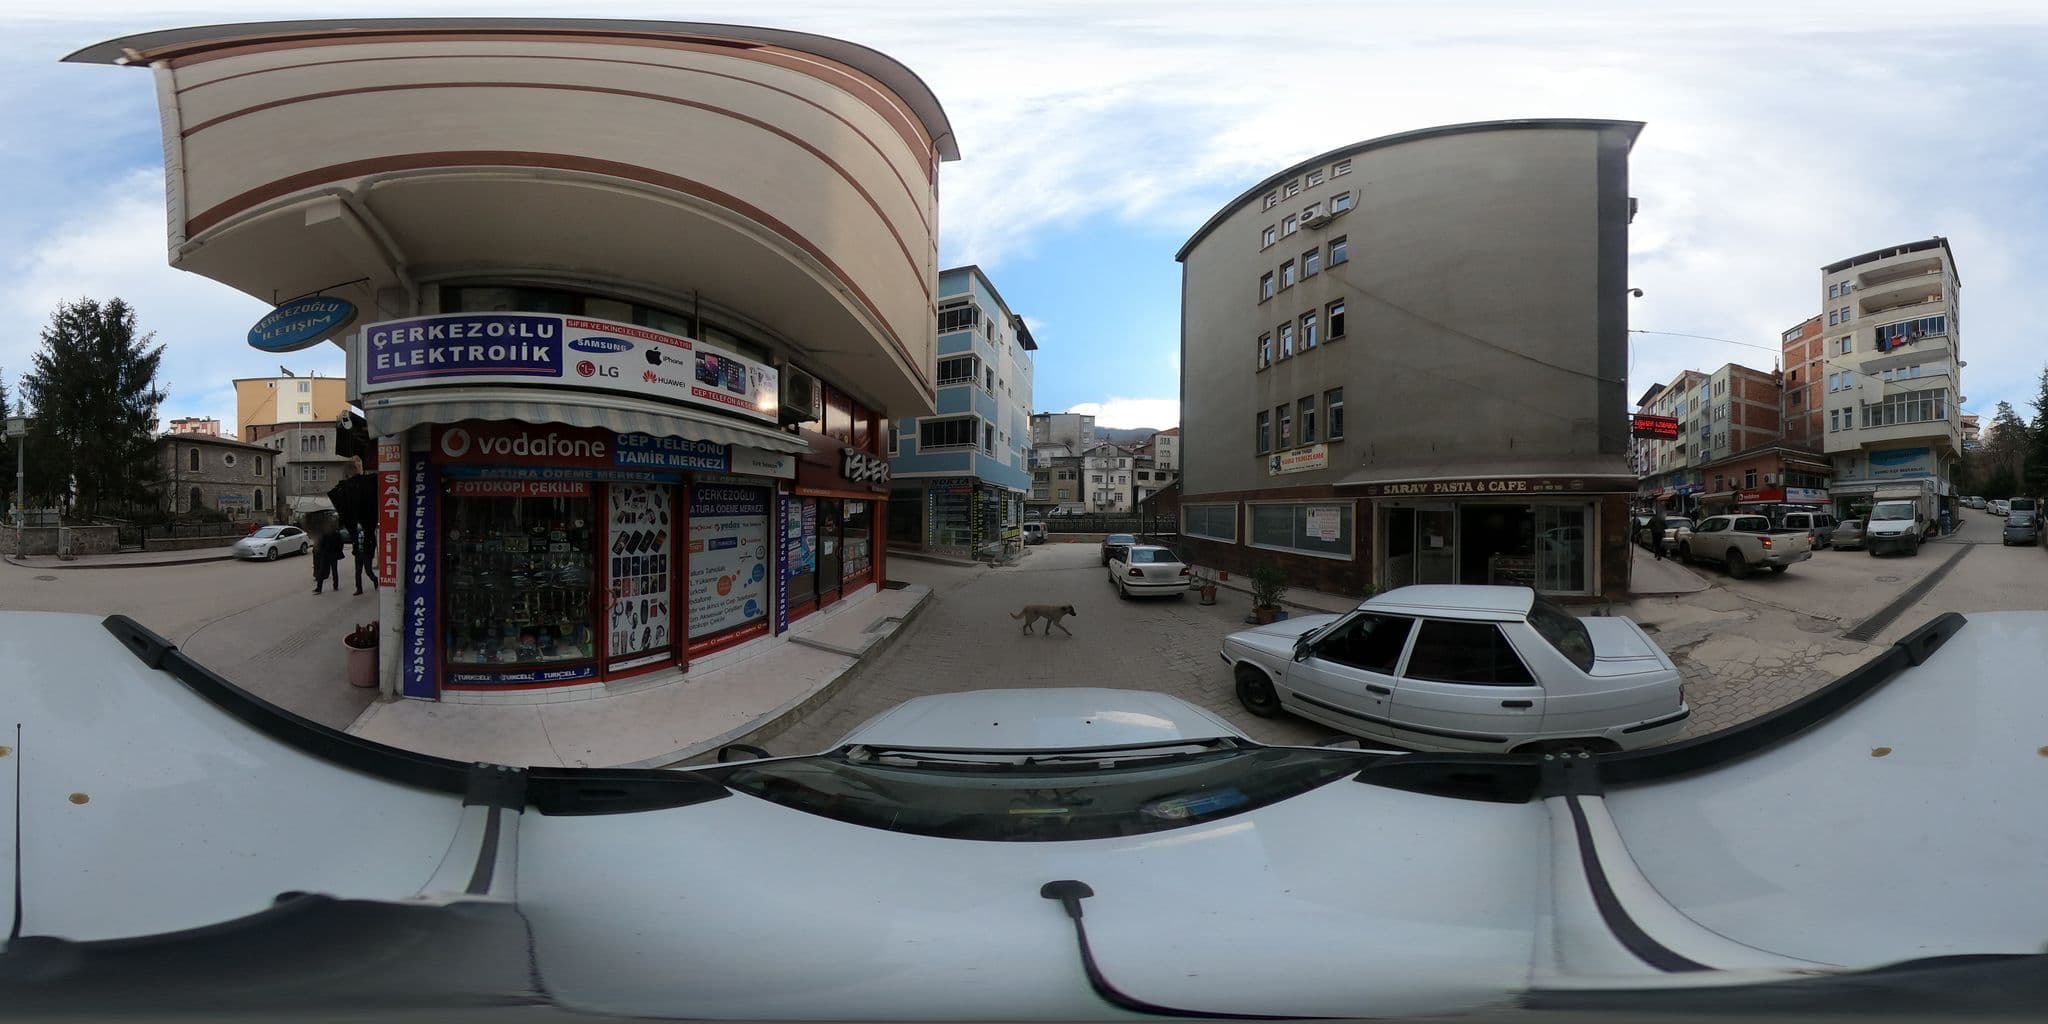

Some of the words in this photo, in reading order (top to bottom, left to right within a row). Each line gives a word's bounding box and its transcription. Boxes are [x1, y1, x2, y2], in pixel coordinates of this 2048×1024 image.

[577, 339, 628, 353] SAMSUNG
[662, 356, 684, 367] iPhone
[599, 365, 619, 378] LG
[658, 377, 686, 389] HUAWEI
[478, 432, 607, 459] vodafone
[617, 433, 649, 447] CEP
[655, 436, 725, 456] TELEFONU
[617, 450, 665, 466] TAMİR
[669, 454, 725, 471] MERKEZİ
[456, 480, 526, 494] FOTOKOPİ
[530, 481, 584, 496] ÇEKİLİR
[1383, 483, 1428, 495] SARAY
[1433, 481, 1473, 493] PASTA
[1477, 481, 1485, 492] &
[1488, 480, 1527, 492] CAFE
[384, 474, 400, 519] SAAT
[697, 488, 756, 503] ÇERKEZOĞLU
[689, 503, 715, 515] ATURA
